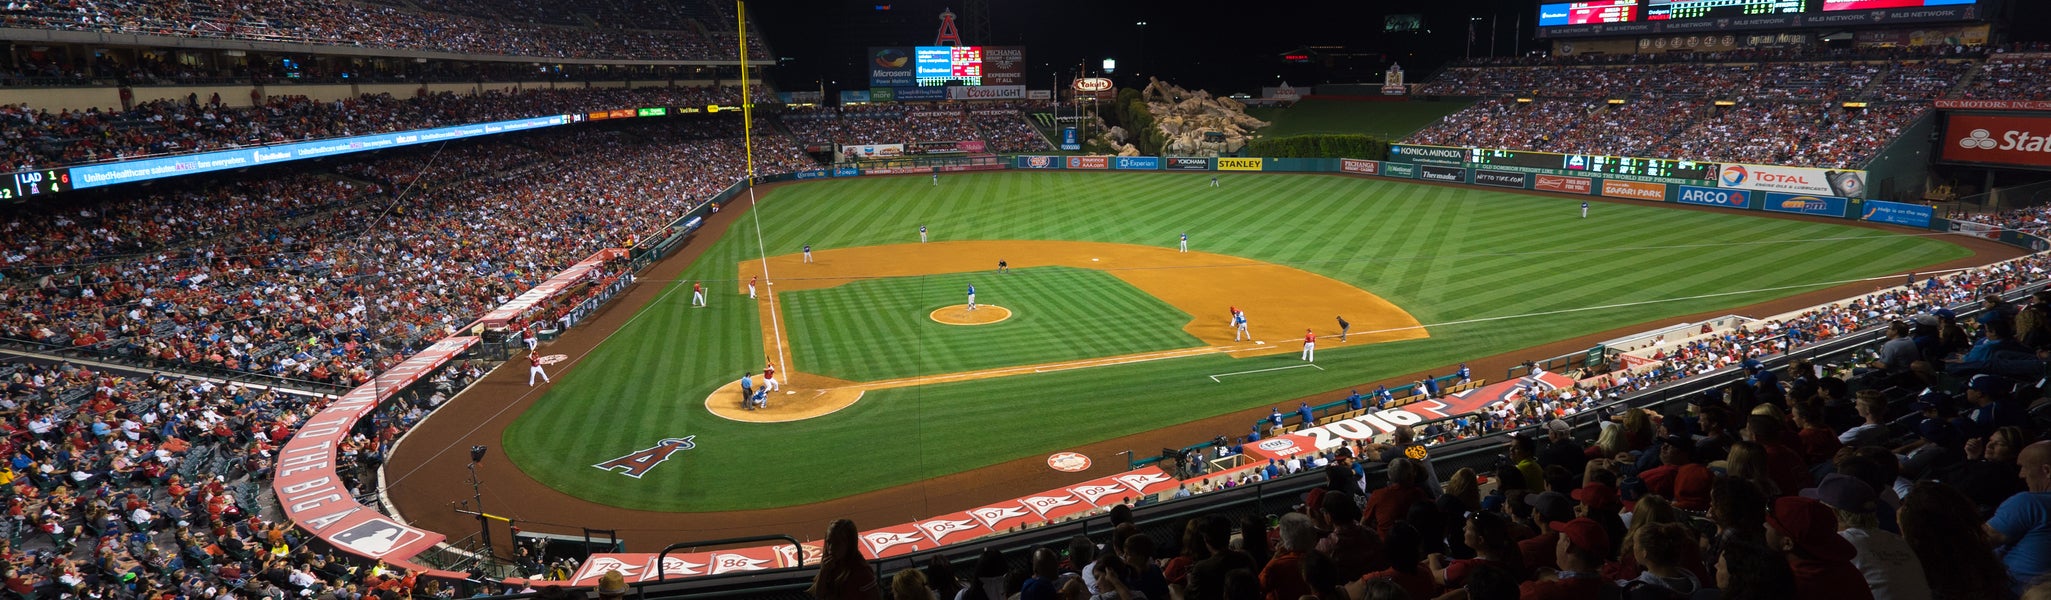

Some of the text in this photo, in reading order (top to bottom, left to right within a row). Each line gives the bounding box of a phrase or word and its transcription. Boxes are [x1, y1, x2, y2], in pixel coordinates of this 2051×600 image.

[1910, 10, 1955, 18] NETWORK
[935, 7, 963, 46] A
[1775, 33, 1805, 44] Morgan
[1080, 80, 1107, 89] Yakult
[967, 86, 996, 98] Coors
[997, 88, 1022, 97] LIGHT
[1999, 130, 2051, 153] Stat
[1400, 147, 1461, 158] KONICA MINOLTA
[1130, 159, 1155, 167] Experian
[1219, 160, 1261, 168] STANLEY
[1345, 160, 1374, 168] PECHANGA
[22, 170, 68, 184] LAD 1 6
[83, 168, 150, 183] UnitedHealthcare
[151, 164, 175, 175] salutes
[198, 160, 210, 169] fans
[841, 169, 857, 177] pepsi
[1422, 170, 1456, 180] Thermador
[1754, 171, 1809, 185] TOTAL
[51, 182, 59, 193] 4
[1605, 186, 1661, 198] SAFARI PARK
[1683, 189, 1728, 203] ARCO
[1877, 206, 1891, 214] Help
[297, 415, 350, 439] TO
[1293, 406, 1422, 451] 2016
[1264, 440, 1284, 449] FOX
[591, 434, 697, 479] A
[1275, 446, 1303, 457] WEST
[280, 439, 333, 478] THE
[1131, 475, 1149, 485] 14
[281, 475, 344, 515] BIG
[304, 505, 362, 531] A
